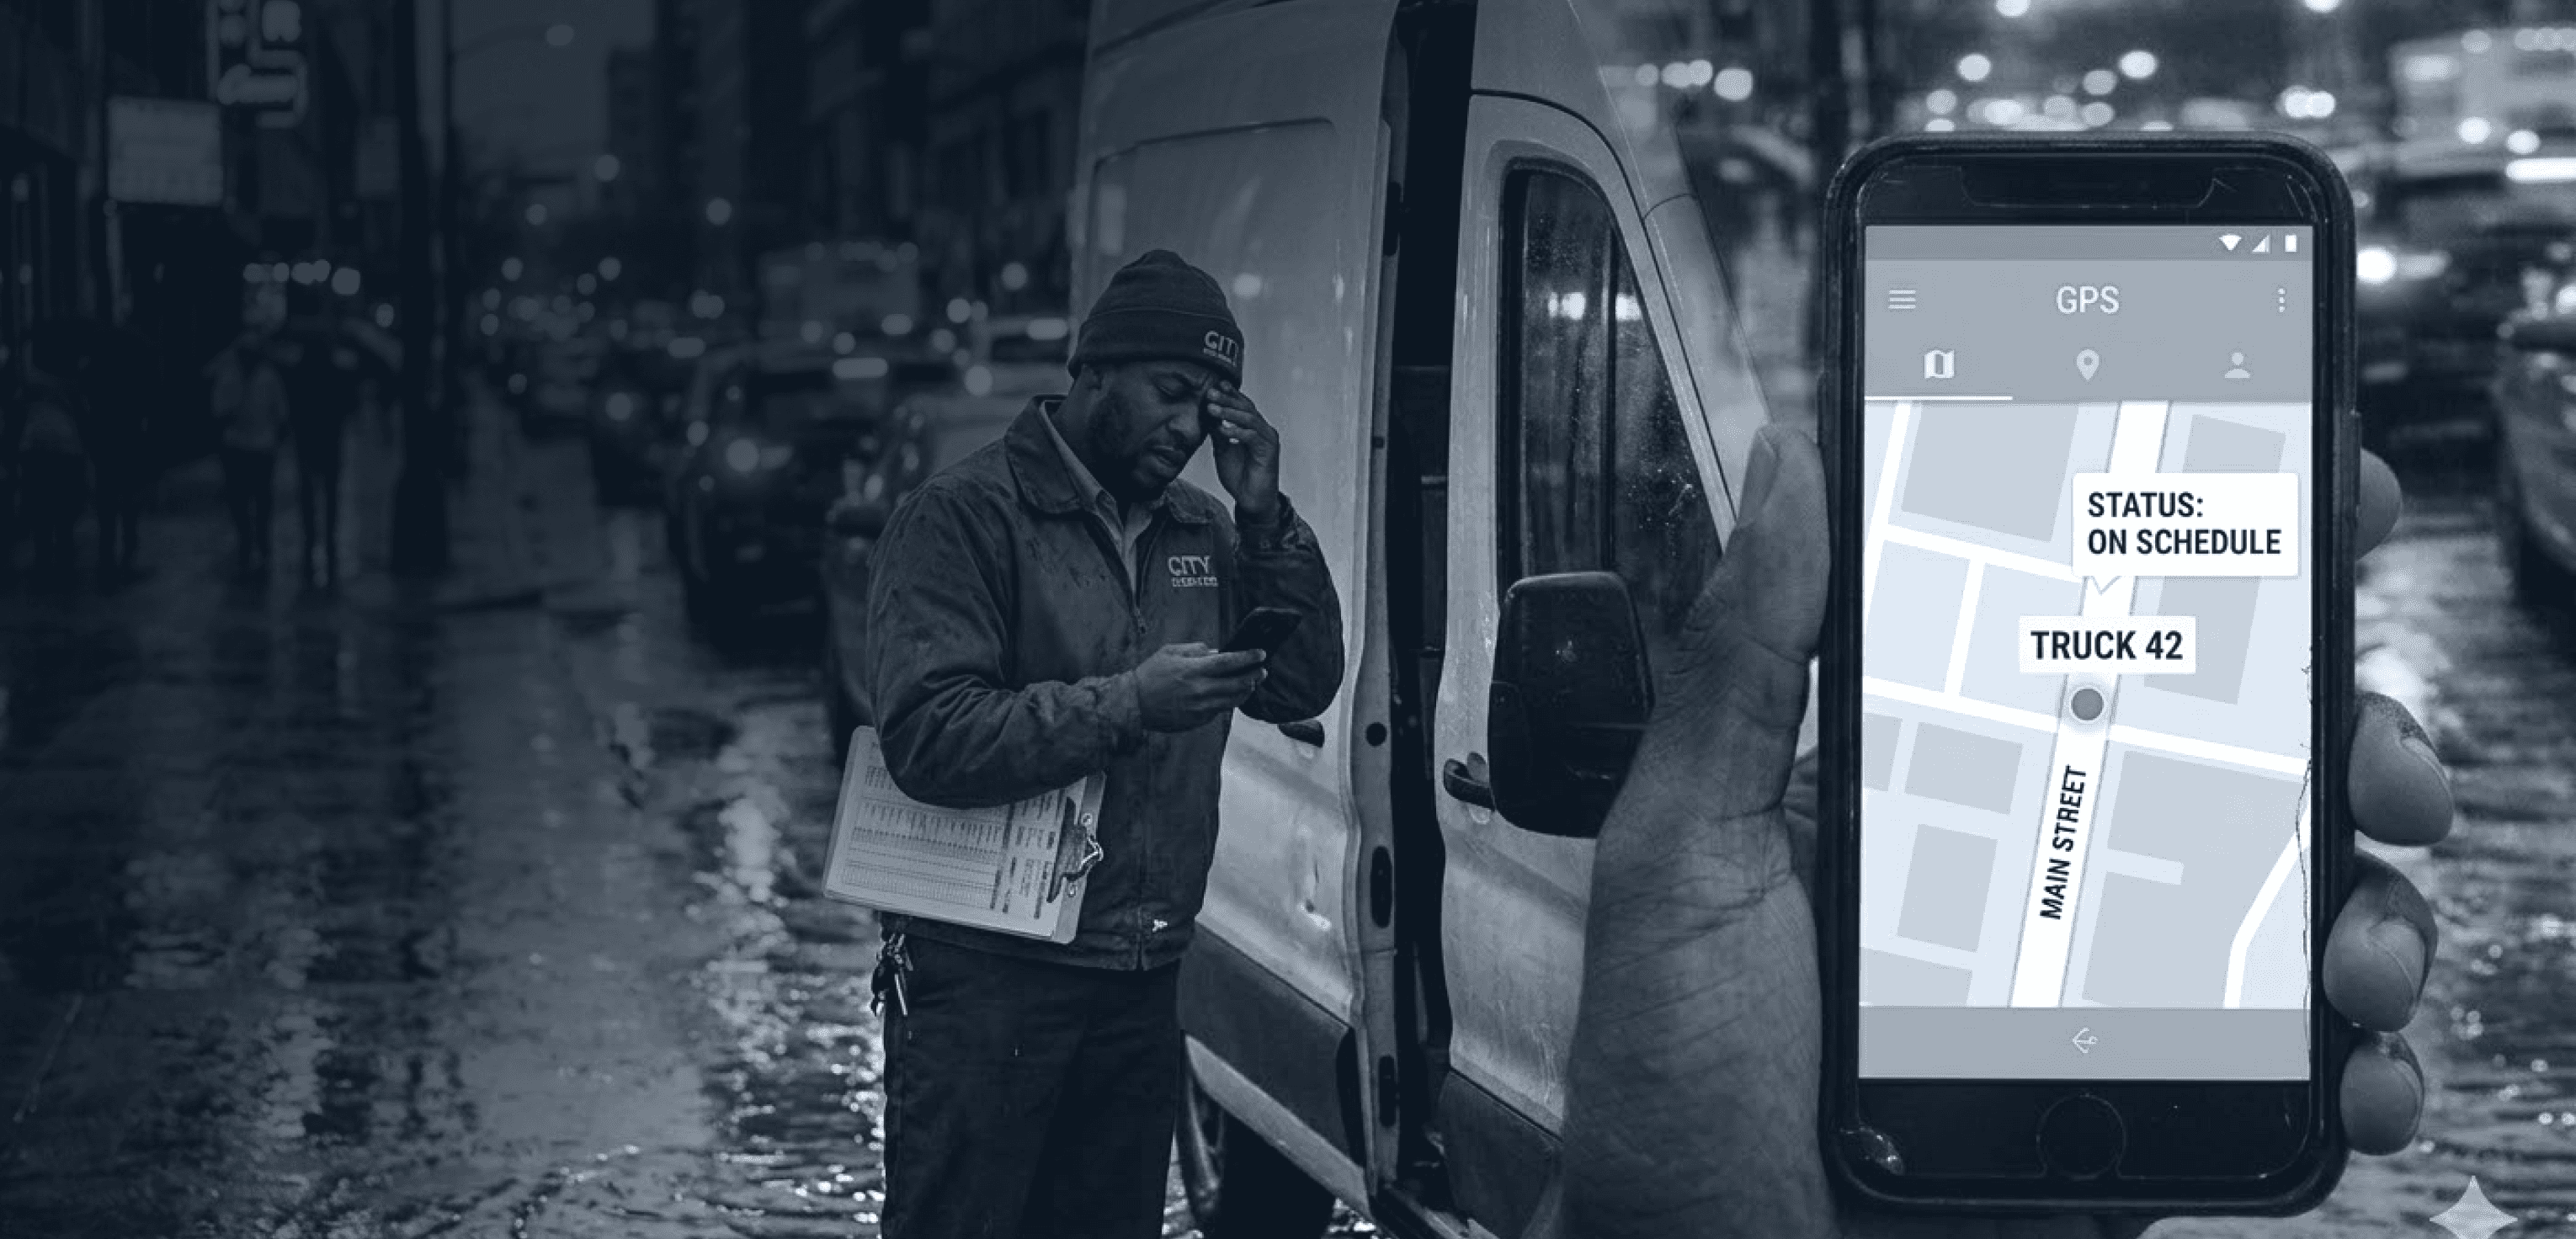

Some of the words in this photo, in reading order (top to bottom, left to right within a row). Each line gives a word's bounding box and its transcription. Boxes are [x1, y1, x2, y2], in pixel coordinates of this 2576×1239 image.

[2056, 285, 2120, 315] GPS
[2088, 491, 2204, 518] STATUS:
[2089, 529, 2126, 555] ON
[2137, 529, 2282, 555] SCHEDULE
[1168, 556, 1211, 576] CITY
[2030, 630, 2137, 661] TRUCK
[2145, 630, 2184, 660] 42
[2052, 765, 2086, 853] STREET
[2040, 859, 2070, 920] MAIN
